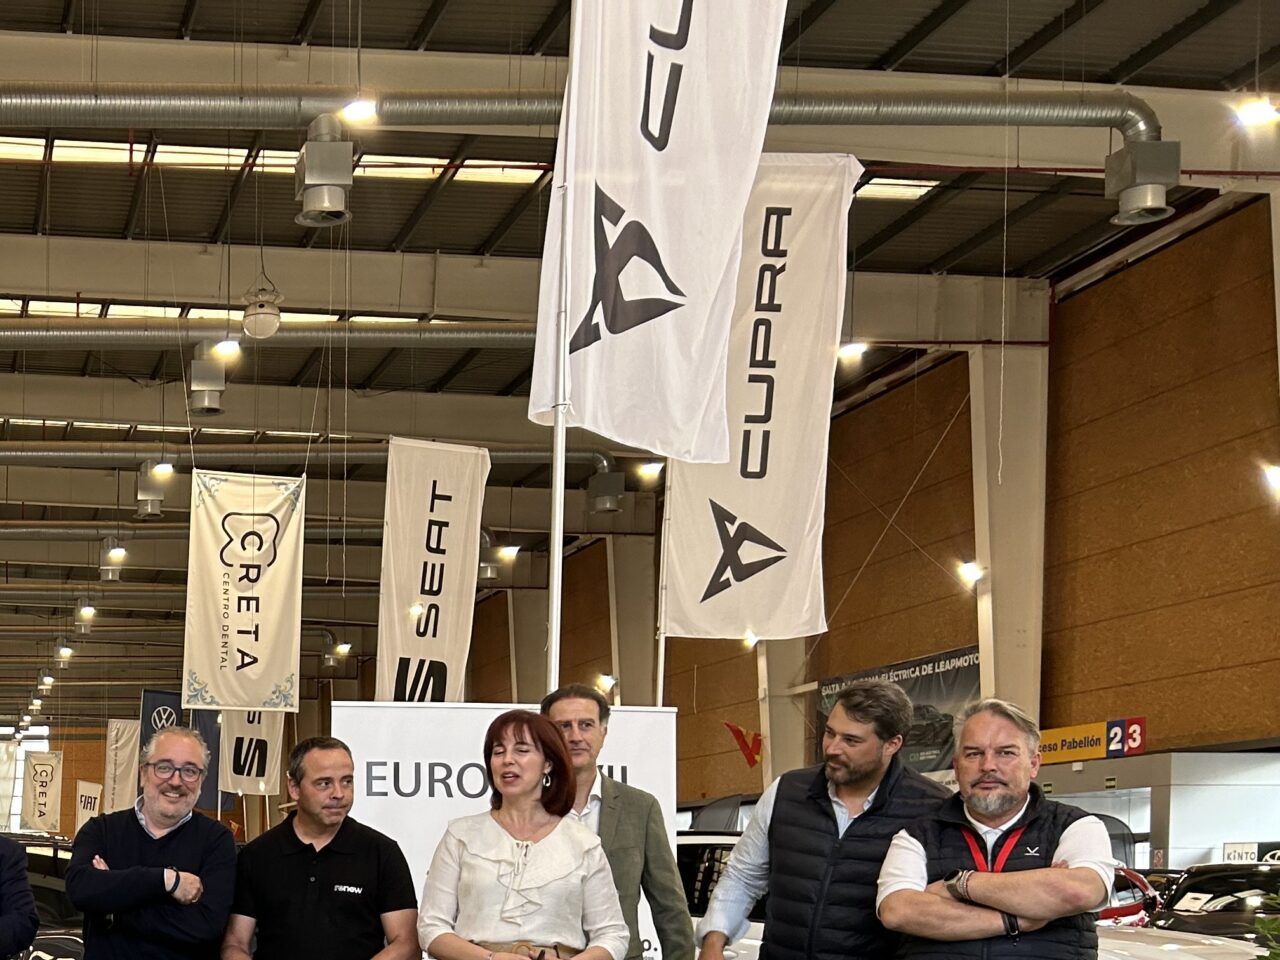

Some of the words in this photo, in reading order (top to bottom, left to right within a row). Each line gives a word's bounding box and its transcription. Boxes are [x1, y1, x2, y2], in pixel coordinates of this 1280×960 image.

[740, 207, 792, 479] CUPRA
[416, 480, 452, 638] SEAT
[222, 572, 230, 620] CENTRO
[236, 530, 264, 671] CRETA
[220, 624, 229, 670] DENTAL
[921, 663, 933, 676] DE
[1061, 735, 1101, 750] Pabellón
[38, 769, 48, 818] CRETA
[80, 795, 97, 811] FIAT
